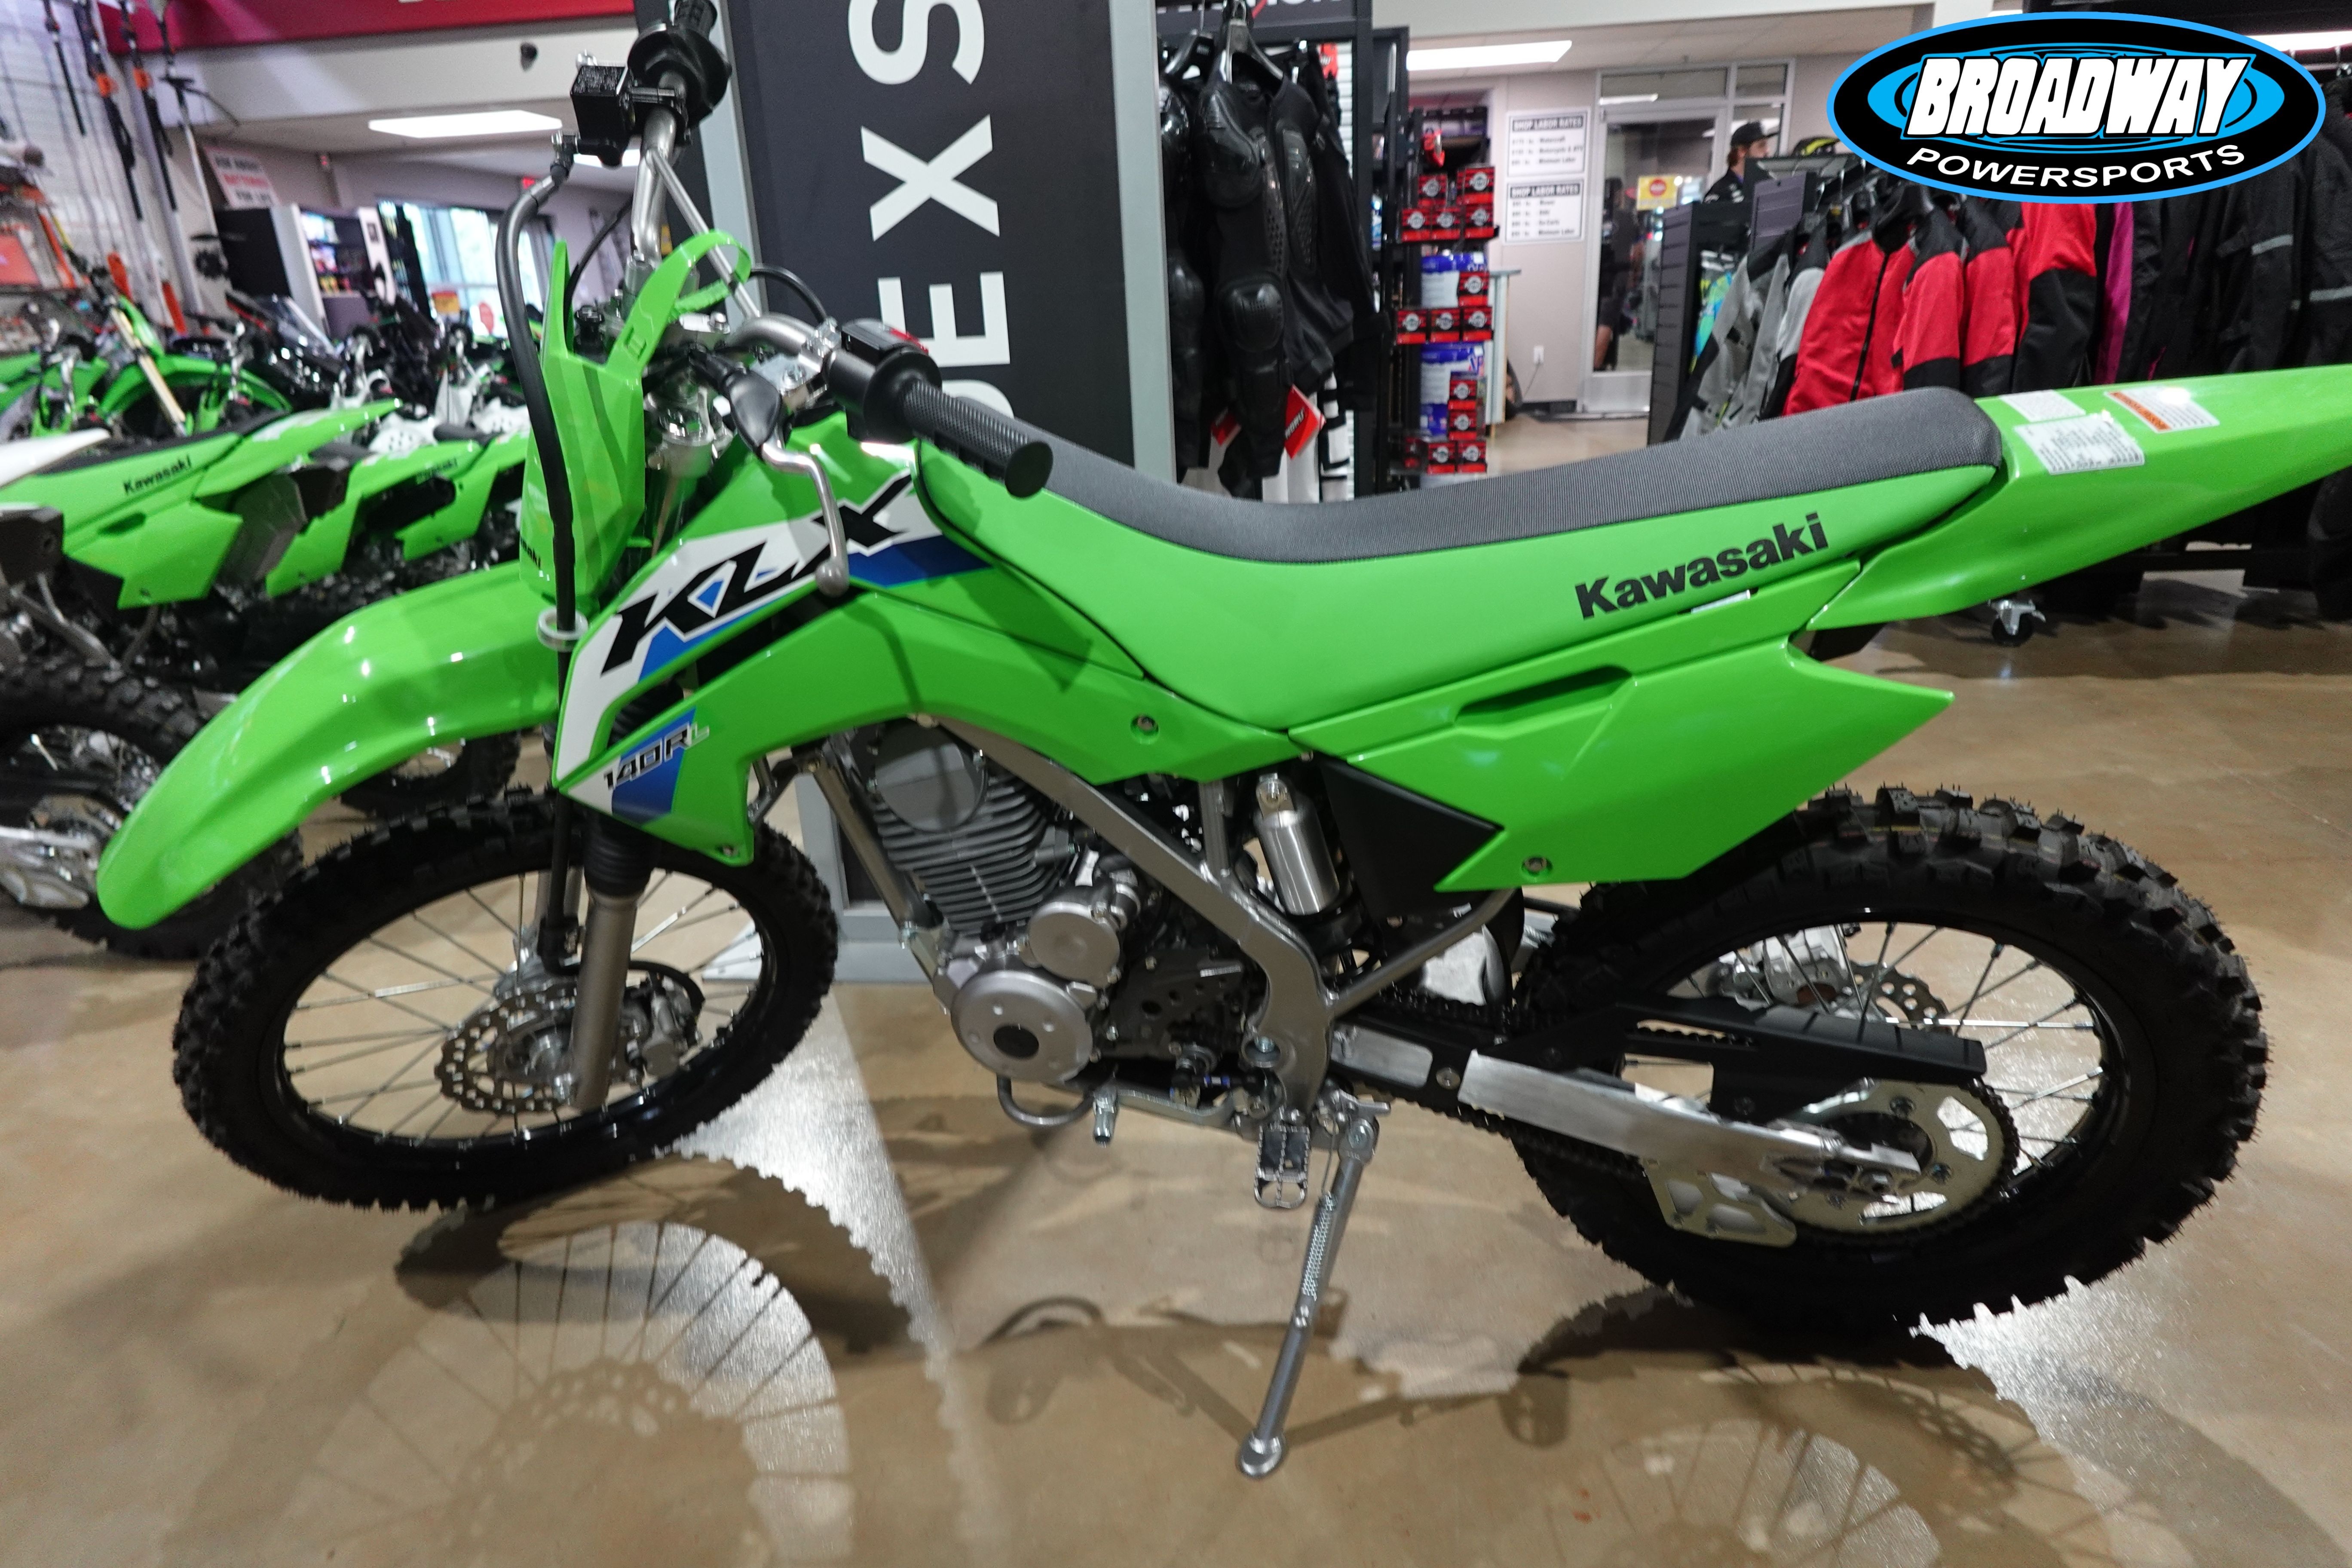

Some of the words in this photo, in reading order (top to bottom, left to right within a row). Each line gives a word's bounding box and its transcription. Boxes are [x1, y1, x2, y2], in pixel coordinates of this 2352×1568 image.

[848, 0, 1014, 418] EXS
[123, 454, 193, 495] Kawasaki
[600, 473, 912, 678] KLX
[1575, 511, 1828, 620] Kawasaki
